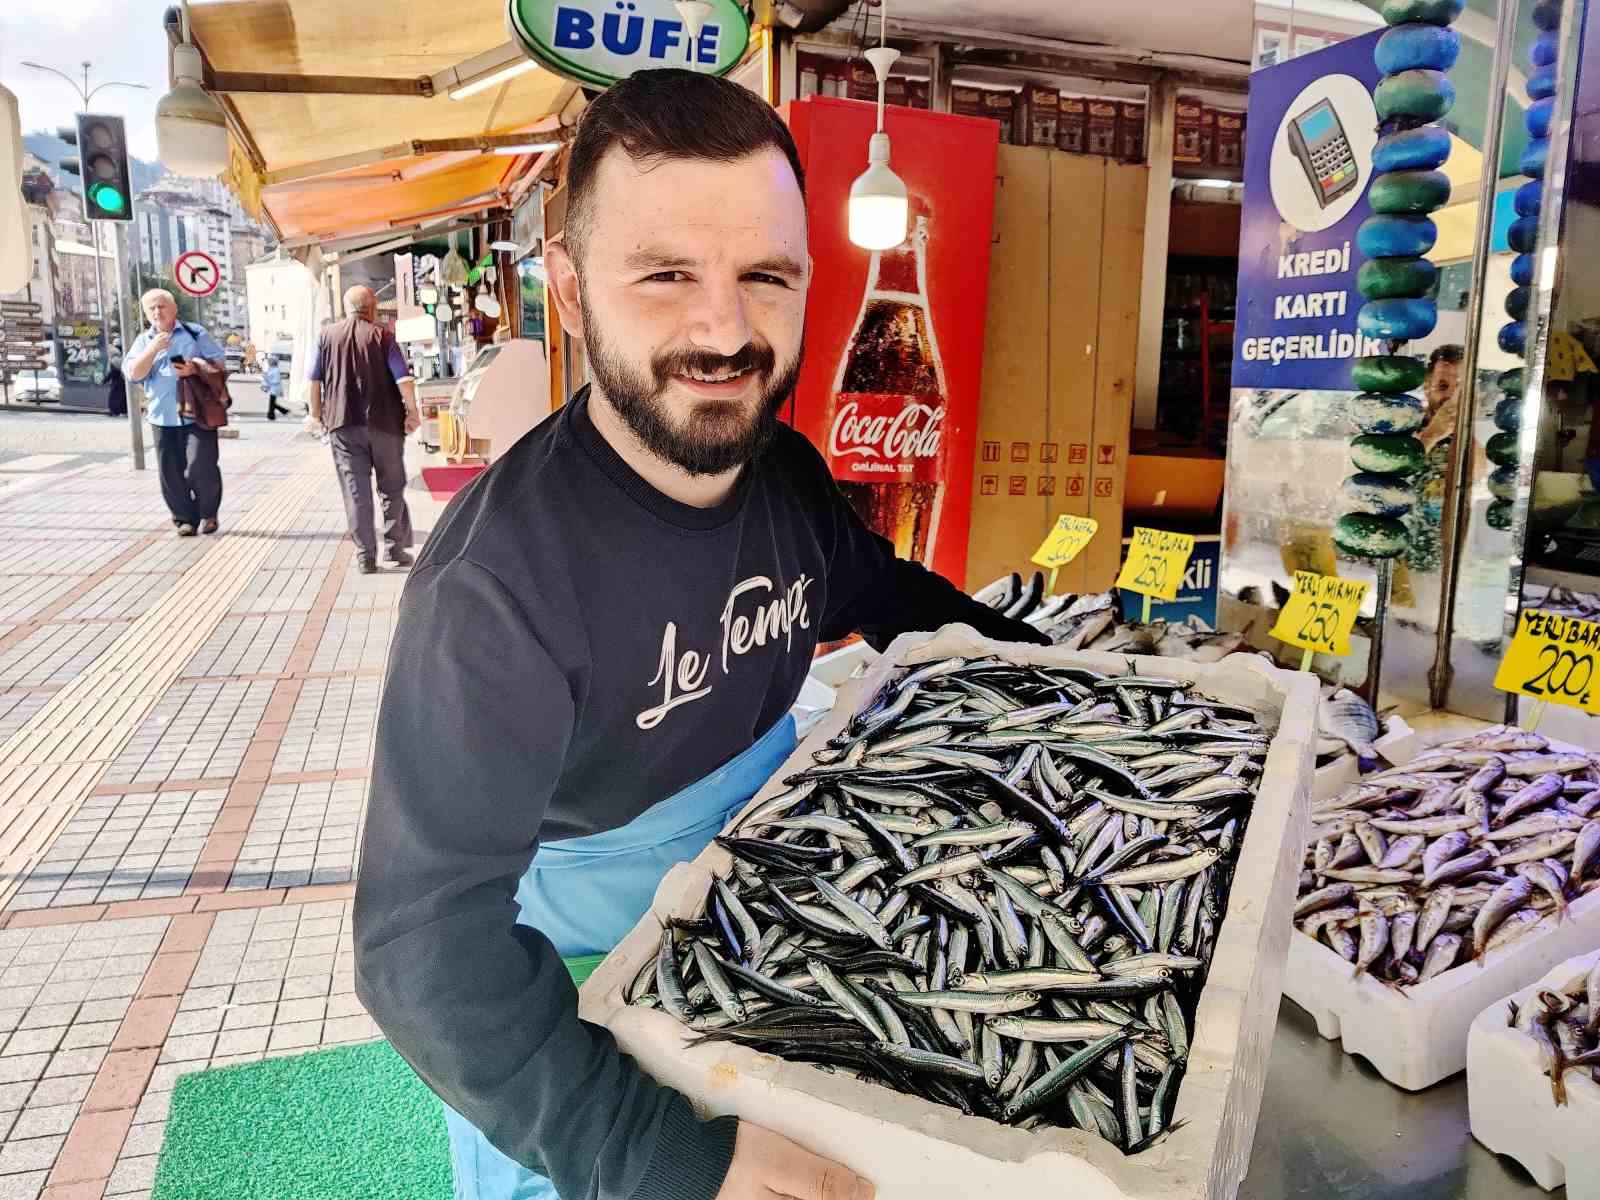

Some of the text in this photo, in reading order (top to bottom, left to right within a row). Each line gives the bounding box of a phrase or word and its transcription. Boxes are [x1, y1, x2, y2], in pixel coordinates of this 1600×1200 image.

[553, 1, 720, 65] BÜFE
[1277, 241, 1351, 279] KREDİ
[1274, 290, 1347, 320] KARTI
[829, 402, 946, 458] Coca-Cola
[636, 621, 713, 730] Le
